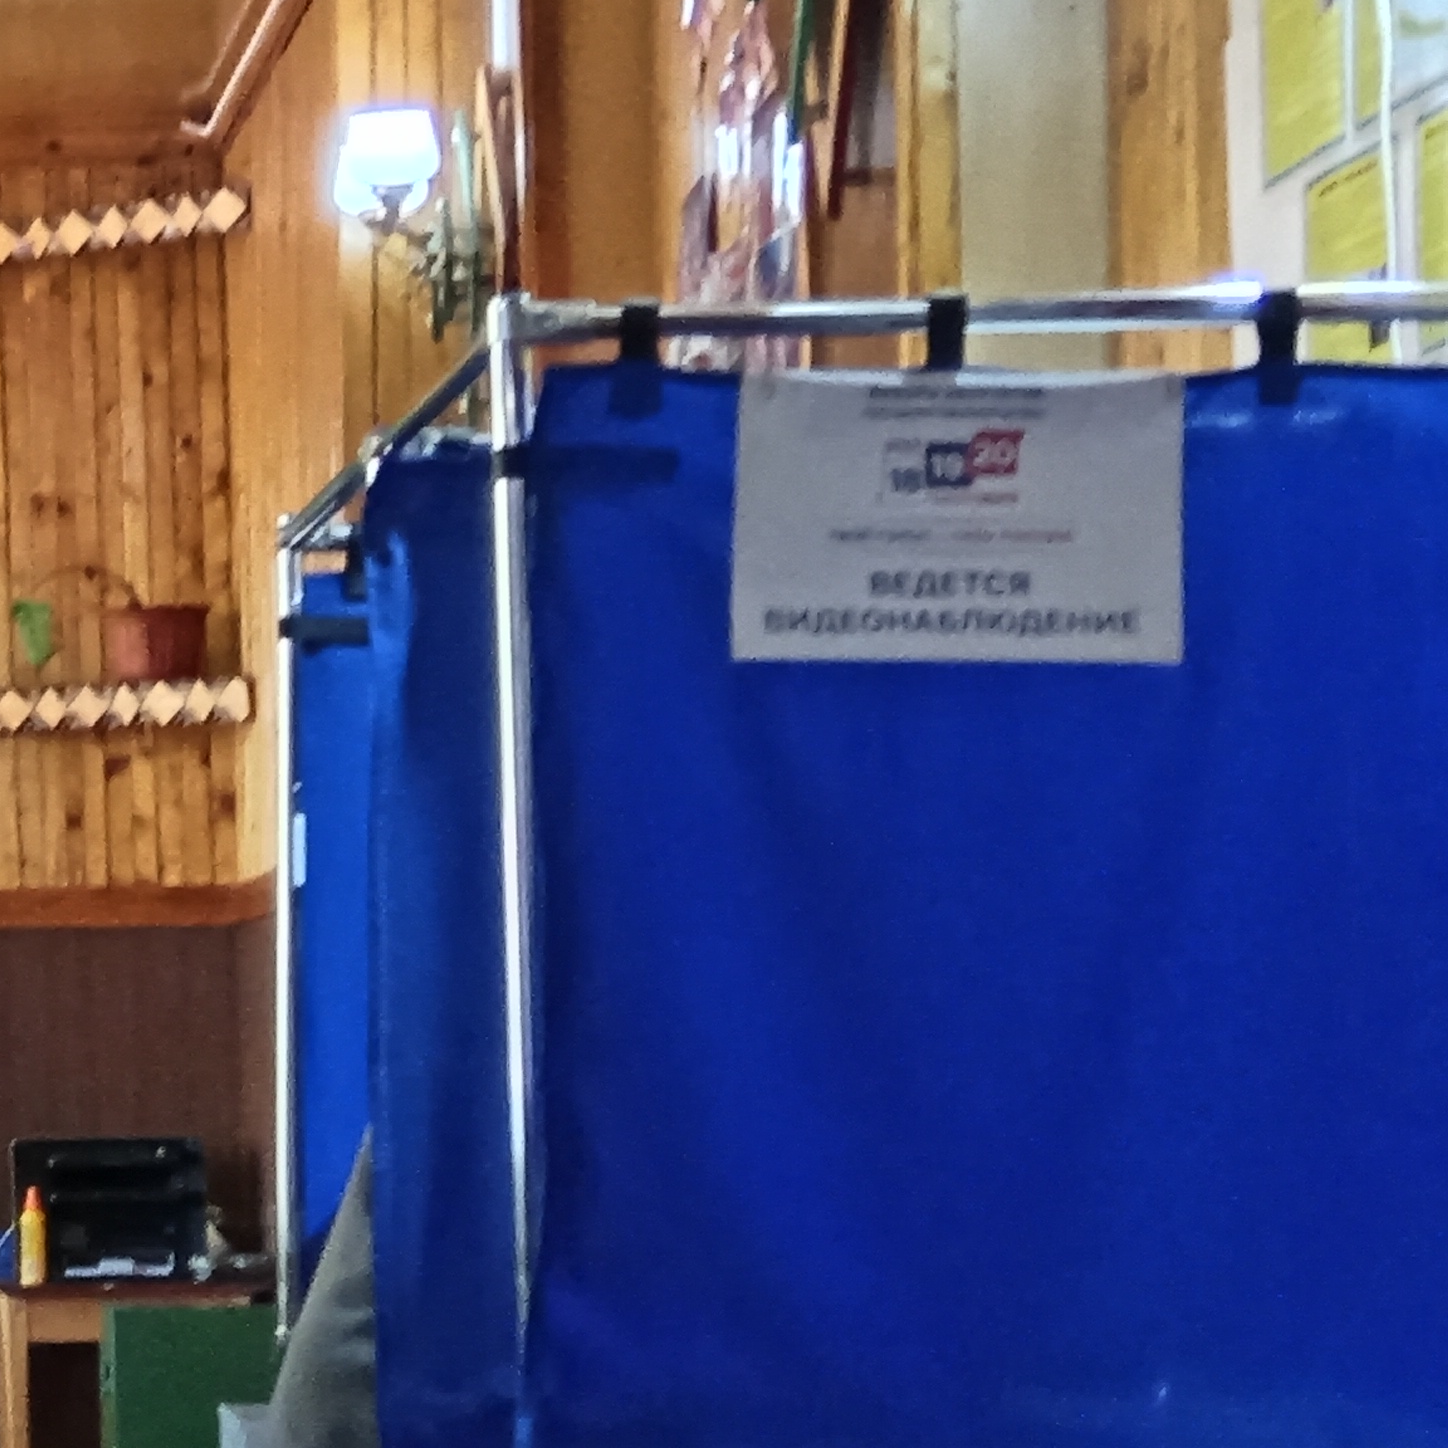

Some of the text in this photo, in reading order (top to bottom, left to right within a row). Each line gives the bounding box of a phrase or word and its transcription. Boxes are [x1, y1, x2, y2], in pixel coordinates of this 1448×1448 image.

[973, 438, 1018, 467] 20
[869, 570, 1031, 598] ВЕДЕТСЯ
[763, 607, 1139, 635] ВИДЕОНАБЛЮДЕНИЕ
